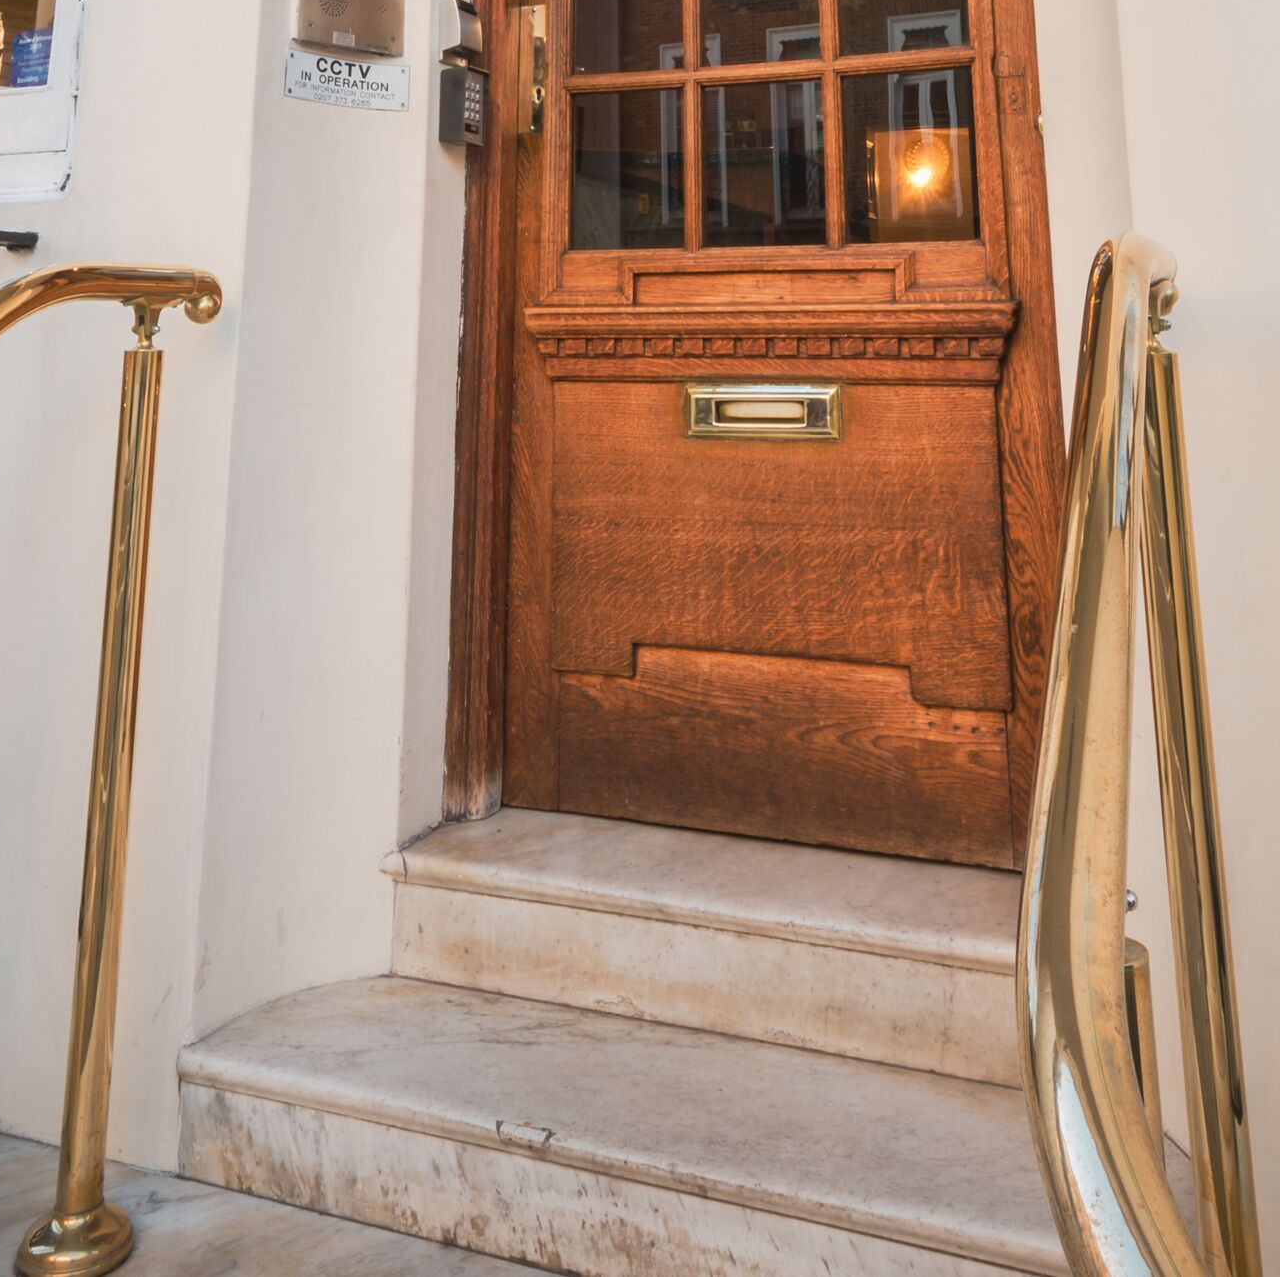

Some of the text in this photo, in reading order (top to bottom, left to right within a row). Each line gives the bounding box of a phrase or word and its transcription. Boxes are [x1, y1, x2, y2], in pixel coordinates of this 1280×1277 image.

[316, 57, 372, 79] CCTV
[295, 80, 396, 101] FOR INFORMATION CONTACT
[300, 70, 389, 92] IN OPERATION
[313, 92, 332, 101] 0207
[334, 96, 348, 104] 373
